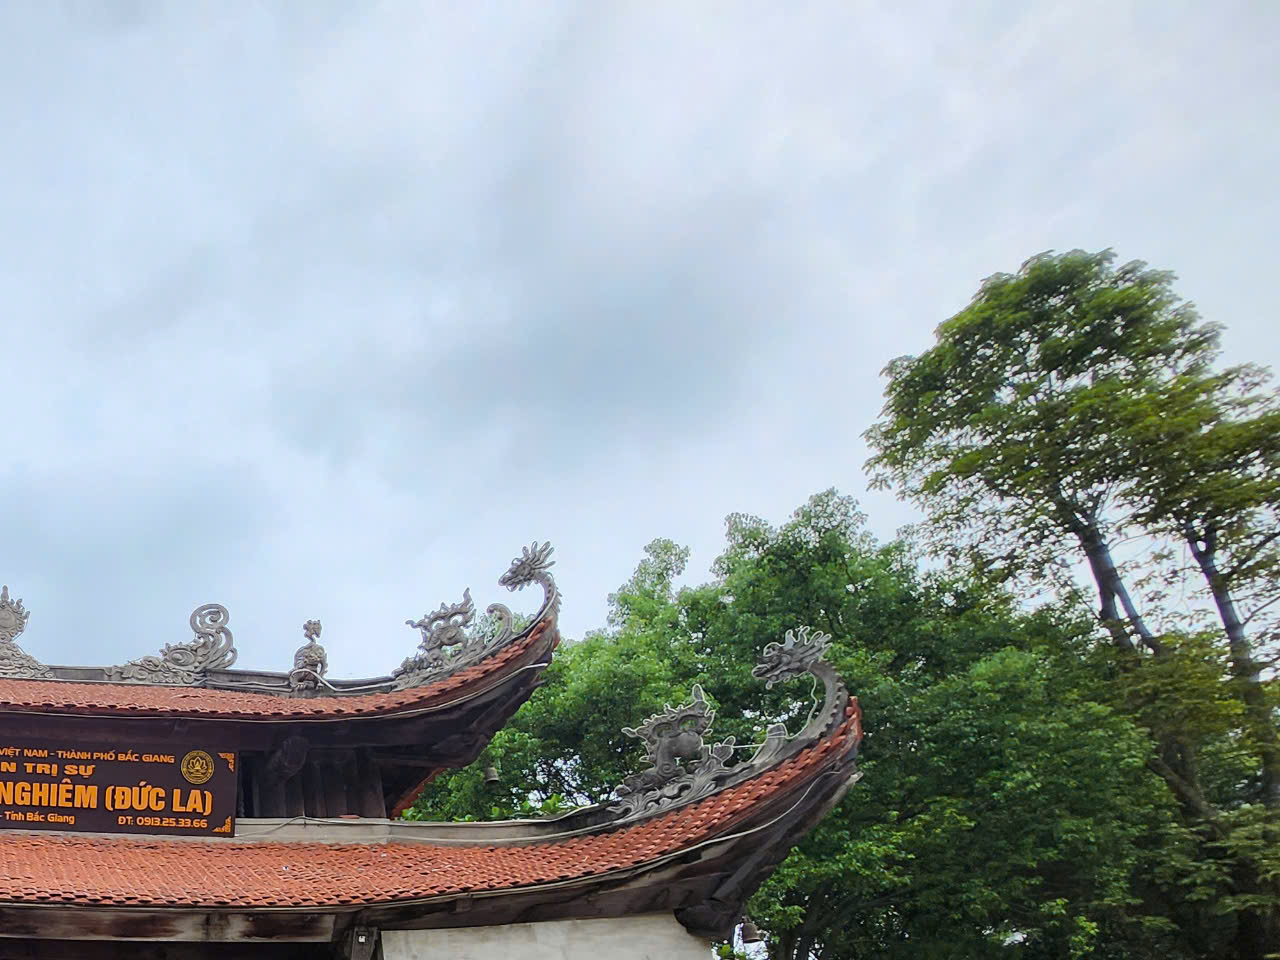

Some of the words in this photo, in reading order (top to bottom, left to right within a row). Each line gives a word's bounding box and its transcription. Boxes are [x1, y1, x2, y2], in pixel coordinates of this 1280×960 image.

[23, 749, 48, 758] NAM
[56, 749, 91, 760] THÀNH
[93, 749, 116, 761] PHỐ
[117, 749, 139, 762] BẮC
[142, 754, 175, 763] GIANG
[23, 762, 58, 777] TRỊ
[63, 764, 96, 778] SỰ
[105, 780, 166, 812] (ĐỨC
[172, 788, 213, 816] LA)
[26, 810, 45, 822] Bắc
[47, 813, 75, 825] Giang
[118, 816, 133, 826] ĐT:
[136, 816, 208, 828] 0913.25.33.66
